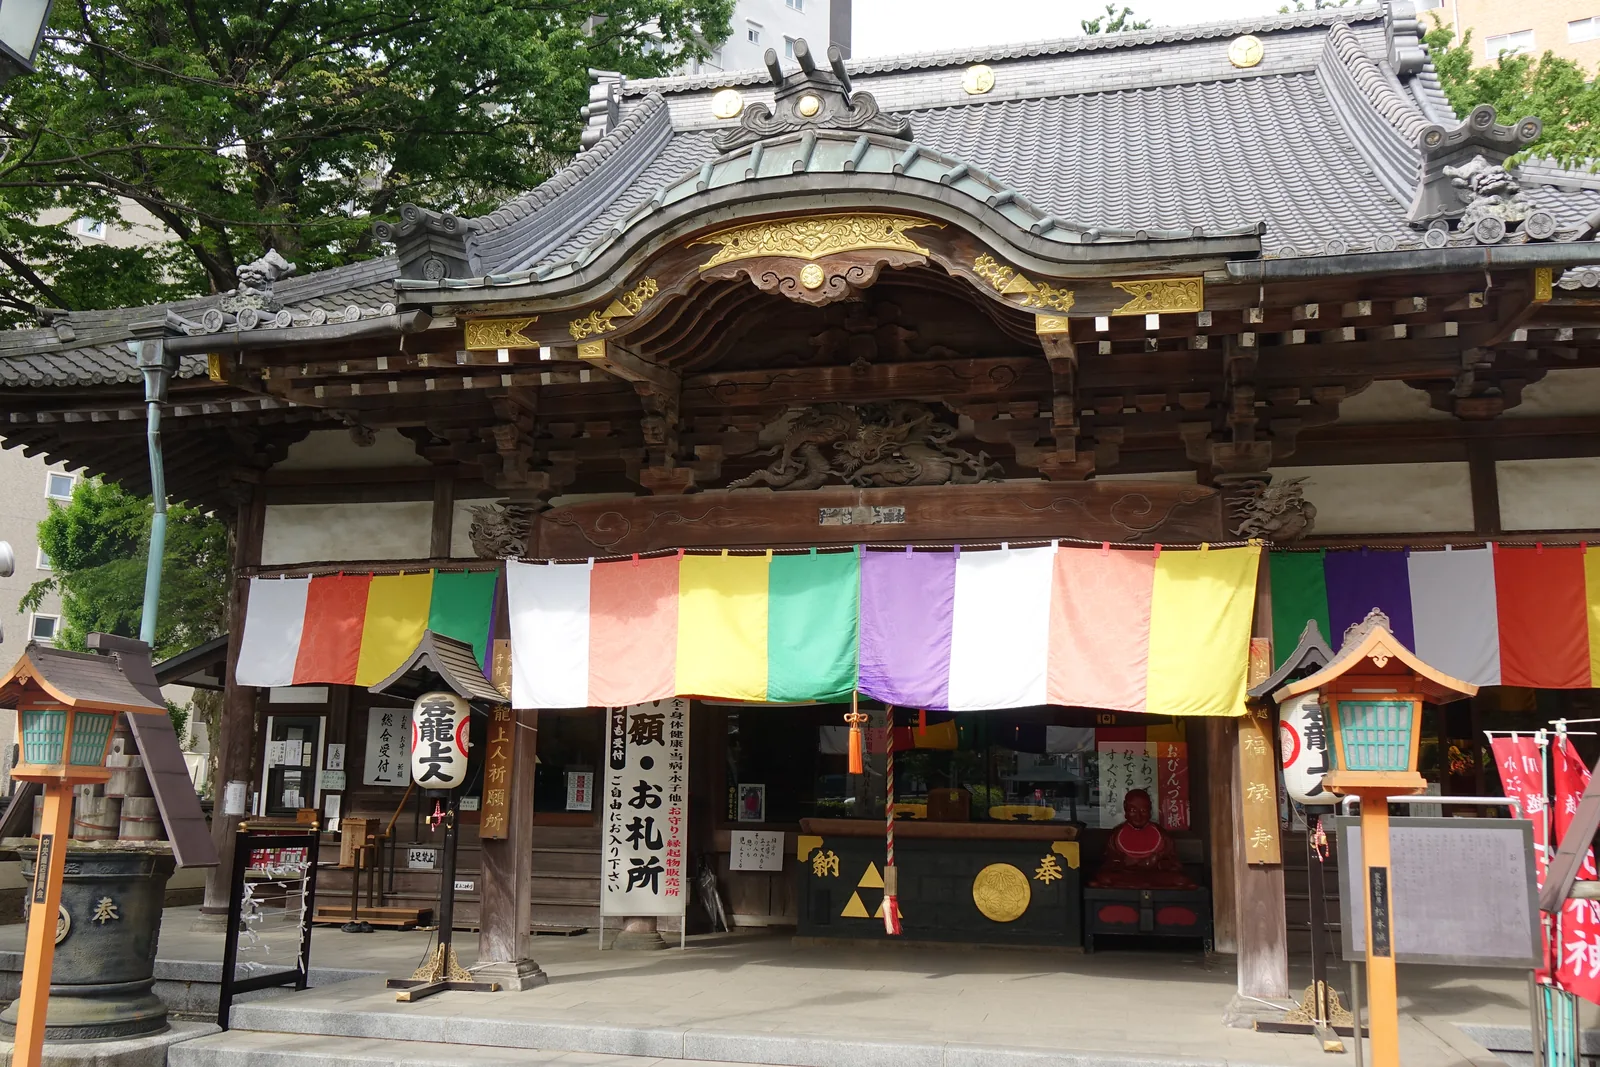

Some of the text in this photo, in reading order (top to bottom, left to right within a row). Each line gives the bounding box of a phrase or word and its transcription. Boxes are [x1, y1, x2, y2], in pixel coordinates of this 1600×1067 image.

[494, 653, 504, 677] 子育
[377, 713, 393, 773] 総合受付
[1105, 749, 1119, 817] すぐなおる
[1123, 749, 1136, 793] なでる
[1166, 743, 1181, 828] おびんづる様
[1244, 734, 1274, 851] 福禄寿
[625, 700, 666, 895] 願・お札所
[410, 851, 434, 863] 土足禁止
[608, 775, 623, 893] ご自由にお入り下さい
[811, 850, 840, 878] 納
[1033, 854, 1064, 886] 奉
[92, 896, 119, 925] 奉
